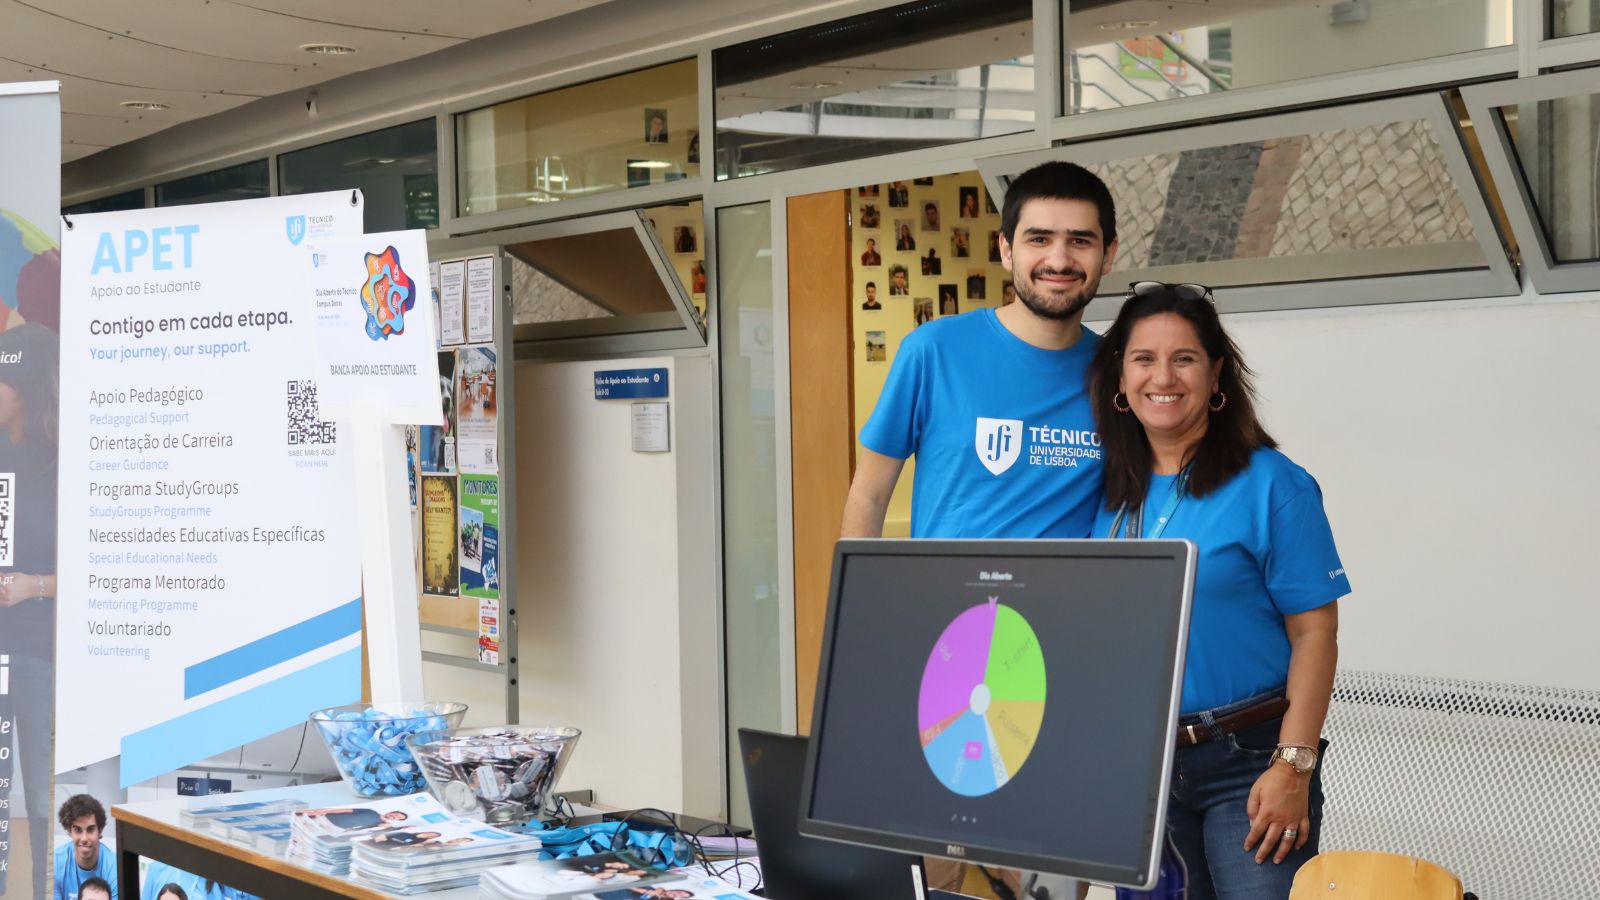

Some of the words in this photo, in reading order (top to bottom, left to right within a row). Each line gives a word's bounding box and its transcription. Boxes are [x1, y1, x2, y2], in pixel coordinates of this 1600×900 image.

[90, 224, 200, 275] APET
[90, 284, 123, 300] Apoio
[126, 285, 141, 296] ao
[143, 279, 201, 295] Estudante
[90, 315, 155, 338] Contigo
[159, 316, 186, 331] em
[190, 311, 233, 330] cada
[237, 309, 293, 331] etapa.
[90, 346, 117, 361] Your
[120, 343, 171, 362] journey,
[173, 344, 195, 356] our
[198, 340, 251, 356] support.
[330, 364, 350, 376] BANCA
[351, 364, 370, 376] APOIO
[370, 364, 379, 375] AO
[380, 364, 417, 376] ESTUDANTE
[89, 389, 126, 407] Apoio
[130, 386, 204, 406] Pedagógico
[89, 411, 148, 427] Pedagogical
[150, 411, 190, 426] Support
[89, 433, 159, 454] Orientação
[163, 433, 179, 449] de
[182, 432, 233, 449] Carreira
[1029, 455, 1042, 465] DE
[1044, 456, 1078, 467] LISBOA
[1030, 445, 1101, 460] UNIVERSIDADE
[89, 460, 121, 472] Career
[123, 458, 169, 471] Guidance
[89, 482, 151, 500] Programa
[155, 480, 239, 499] StudyGroups
[89, 505, 152, 520] StudyGroups
[154, 506, 212, 519] Programme
[89, 527, 176, 543] Necessidades
[180, 527, 249, 543] Educativas
[253, 525, 325, 546] Específicas
[88, 552, 124, 565] Special
[126, 551, 184, 564] Educational
[186, 552, 217, 564] Needs
[88, 575, 151, 593] Programa
[155, 575, 226, 590] Mentorado
[88, 598, 138, 613] Mentoring
[140, 599, 198, 613] Programme
[88, 620, 172, 637] Voluntariado
[87, 644, 150, 660] Volunteering
